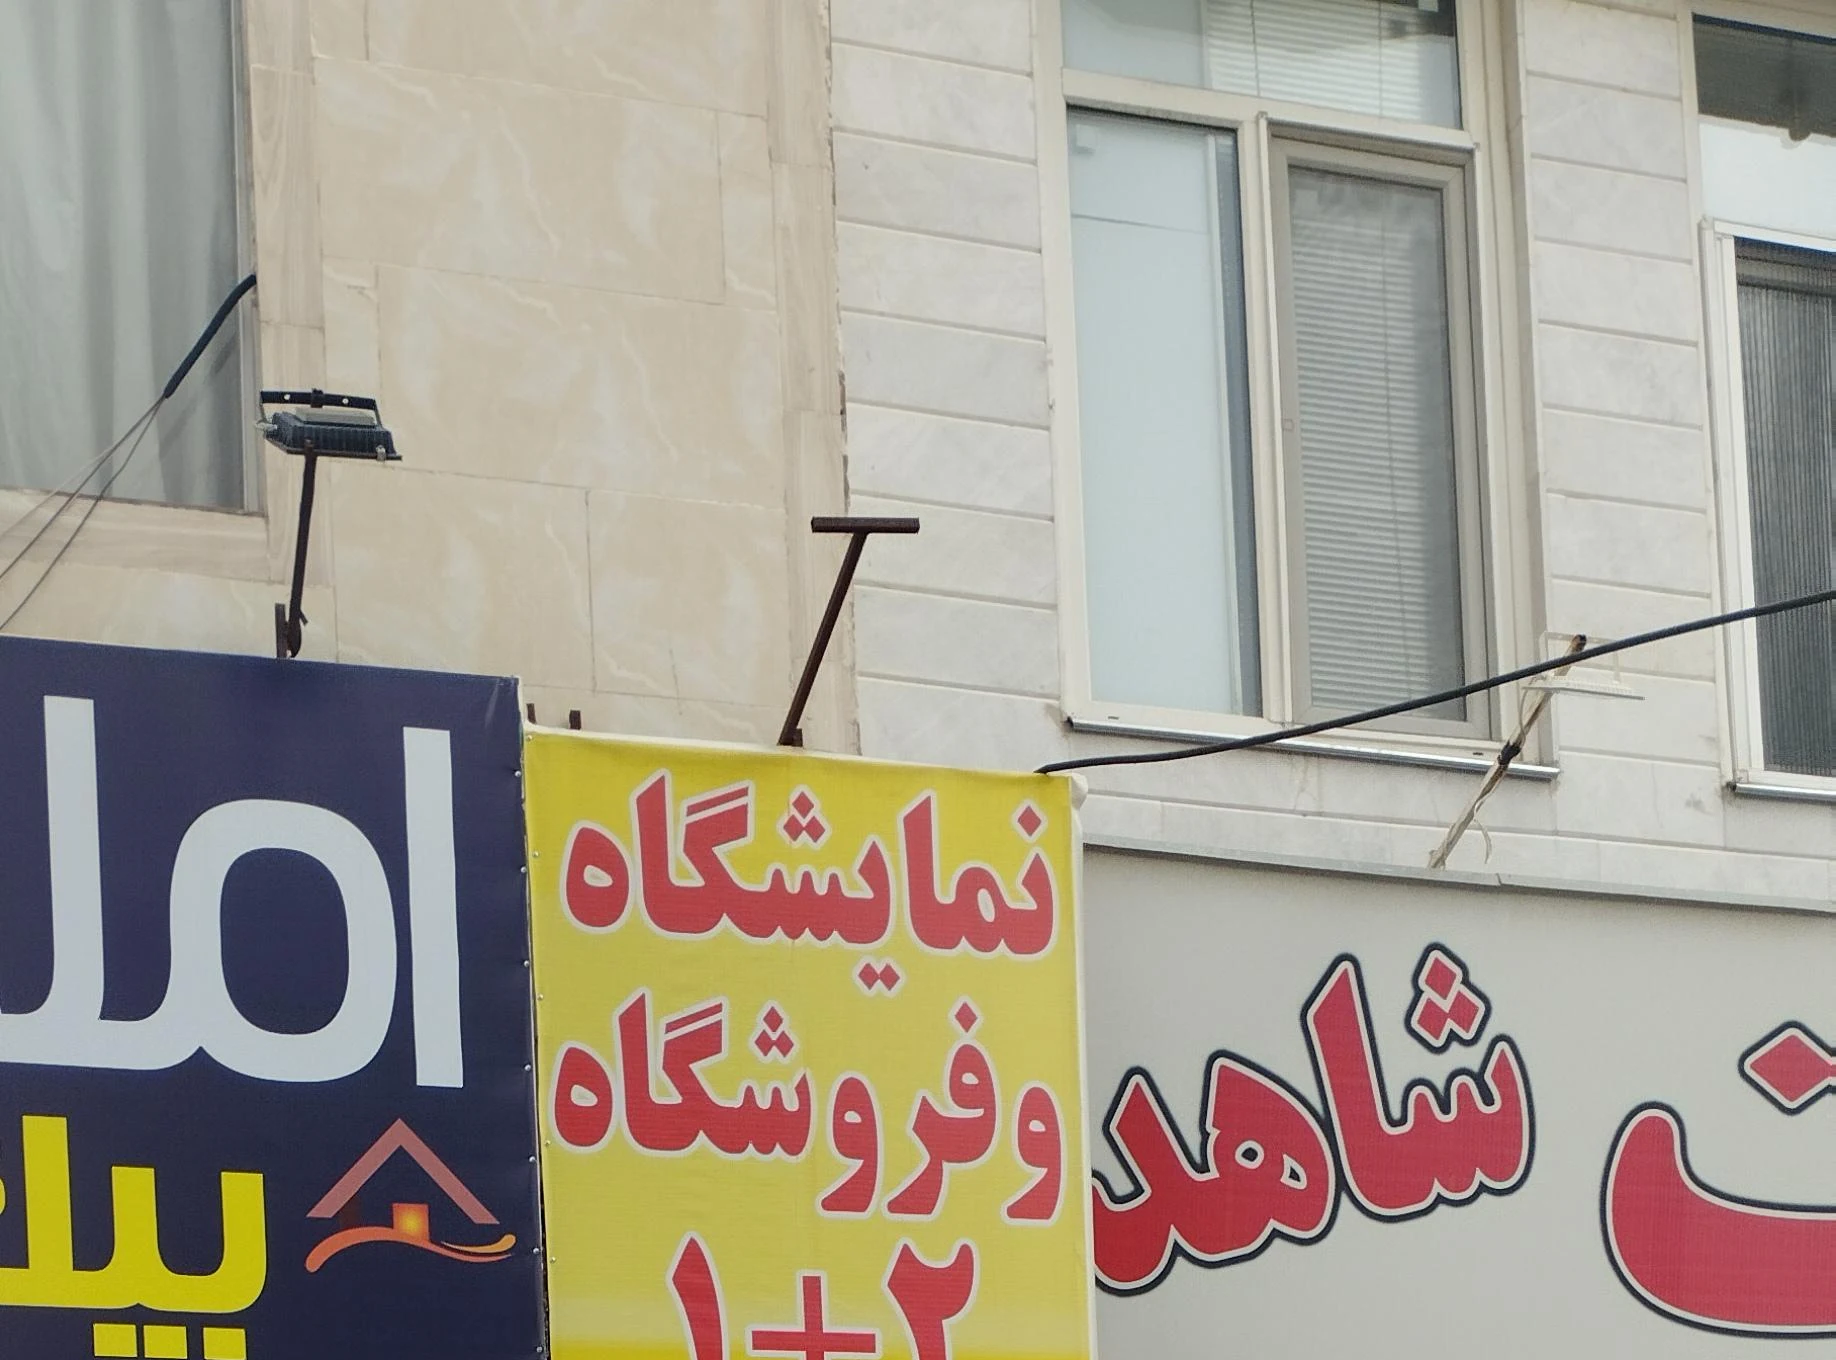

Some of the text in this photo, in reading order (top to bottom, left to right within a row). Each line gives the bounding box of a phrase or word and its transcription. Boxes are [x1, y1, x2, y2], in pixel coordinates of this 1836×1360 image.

[0, 694, 464, 1089] امل
[562, 769, 1058, 994] نمایشگاه
[1092, 943, 1536, 1297] شاهد
